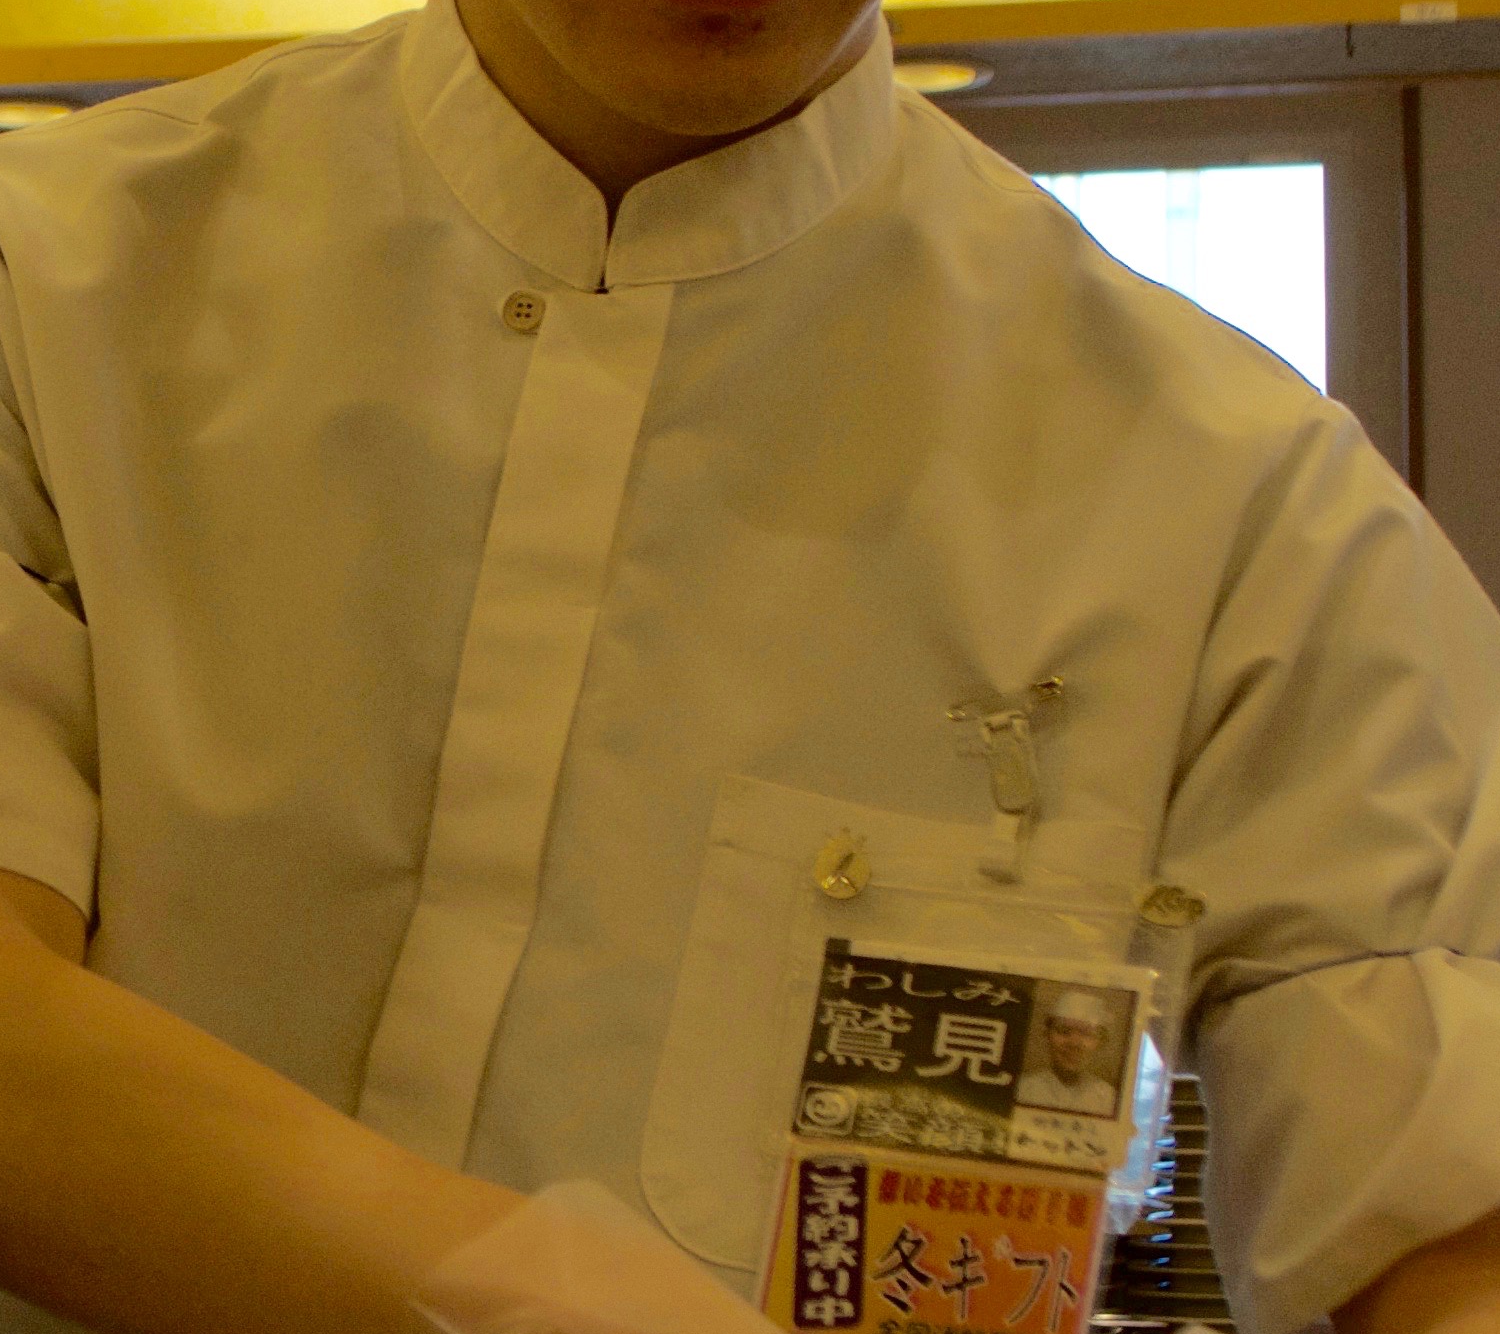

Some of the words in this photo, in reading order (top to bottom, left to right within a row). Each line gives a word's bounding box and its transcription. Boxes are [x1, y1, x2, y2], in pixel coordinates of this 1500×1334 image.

[826, 961, 1022, 1008] わしみ
[812, 997, 1014, 1085] 鷲見
[801, 1155, 863, 1327] ご予約承り中
[871, 1223, 1080, 1334] 冬ギフト
